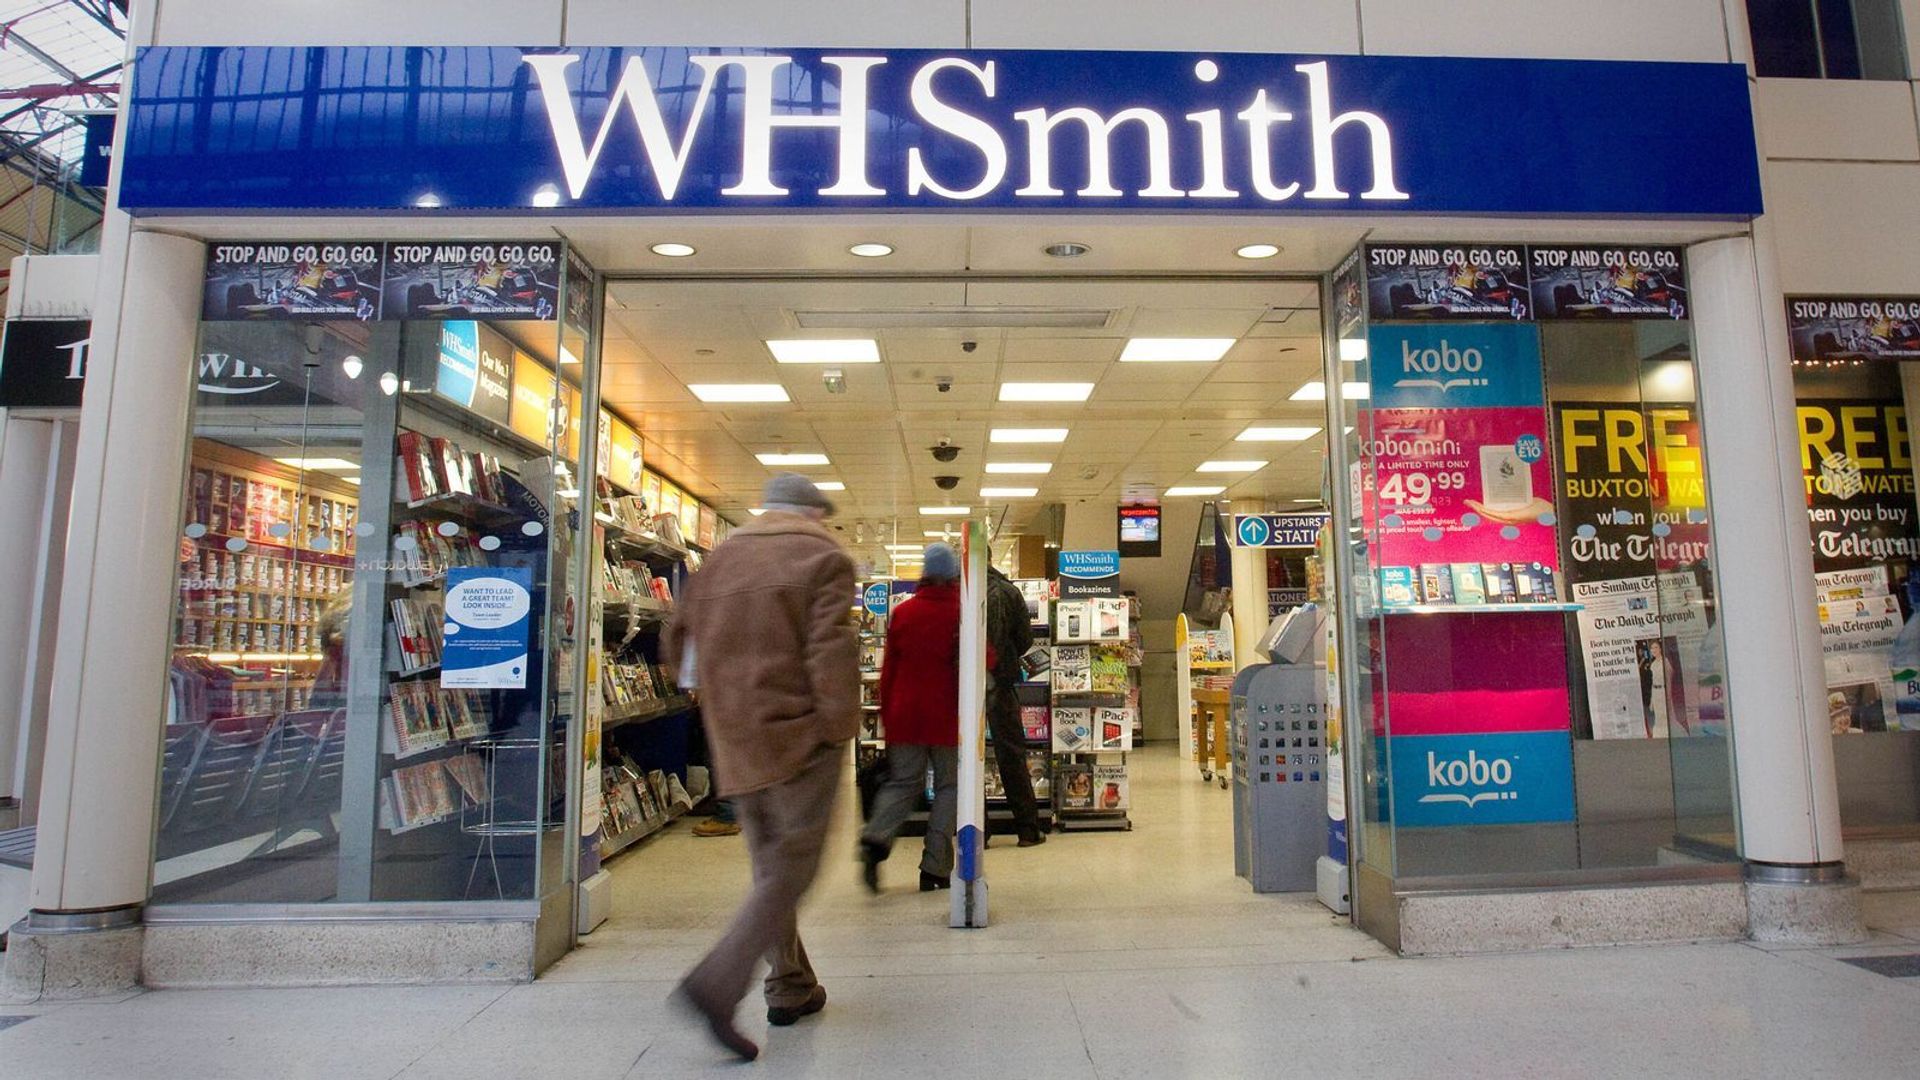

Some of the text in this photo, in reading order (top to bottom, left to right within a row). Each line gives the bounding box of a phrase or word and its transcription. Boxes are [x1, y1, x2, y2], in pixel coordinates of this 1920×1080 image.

[522, 54, 1411, 201] WHSmith
[215, 245, 378, 266] STOP AND GO, GO, GO.
[393, 245, 556, 265] STOP AND GO, GO, GO.
[1371, 248, 1521, 268] STOP AND GO, GO, GO.
[1534, 250, 1679, 269] STOP AND GO, GO, GO.
[1794, 301, 1827, 318] STOP
[1829, 302, 1857, 318] AND
[1860, 302, 1884, 320] GO,
[1885, 302, 1909, 320] GO,
[482, 350, 495, 371] Our
[1517, 439, 1541, 449] SAVE
[1517, 447, 1541, 459] £10
[1387, 461, 1422, 470] LIMITED
[1424, 460, 1445, 469] TIME
[1447, 460, 1470, 469] ONLY
[1566, 479, 1660, 498] BUXTON
[1273, 517, 1321, 527] UPSTAIRS
[1597, 507, 1645, 526] whn
[1841, 508, 1871, 527] you
[1876, 502, 1907, 525] buy
[1571, 534, 1622, 562] The
[1064, 553, 1114, 564] WHSmith
[1068, 585, 1112, 595] Bookazines
[1578, 575, 1690, 597] The Sunday Teegraph
[1594, 617, 1616, 630] The
[1617, 615, 1645, 628] Daily
[1843, 617, 1893, 632] Telegraph
[1055, 710, 1083, 719] iPhone
[1101, 710, 1124, 721] iPad
